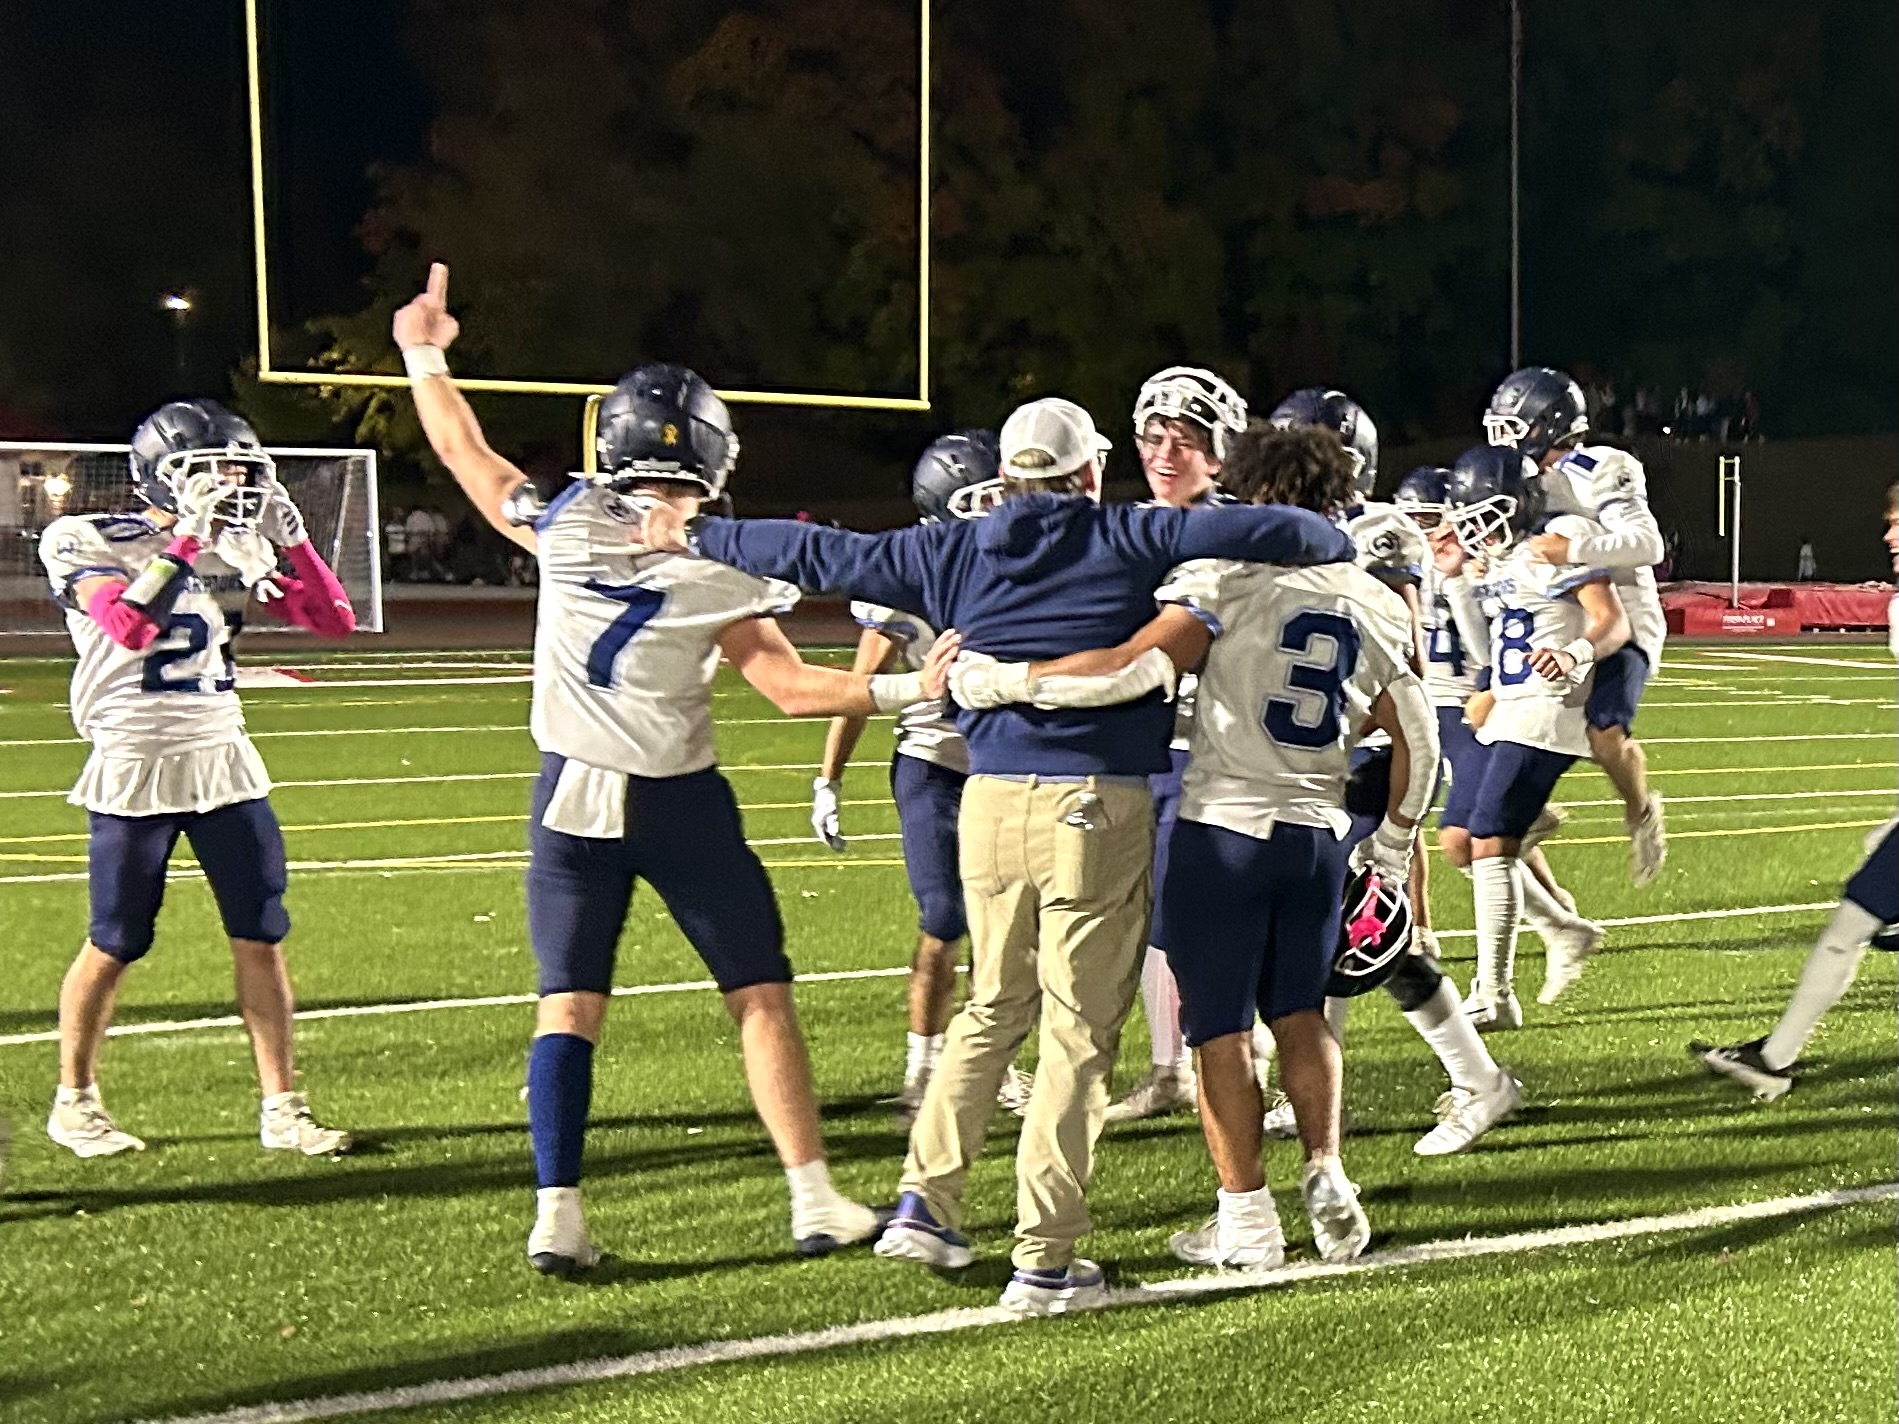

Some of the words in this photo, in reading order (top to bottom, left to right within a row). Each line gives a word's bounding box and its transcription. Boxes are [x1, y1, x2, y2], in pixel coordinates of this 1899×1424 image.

[581, 578, 667, 691] 7
[1261, 606, 1361, 751] 3
[1498, 607, 1534, 686] 8
